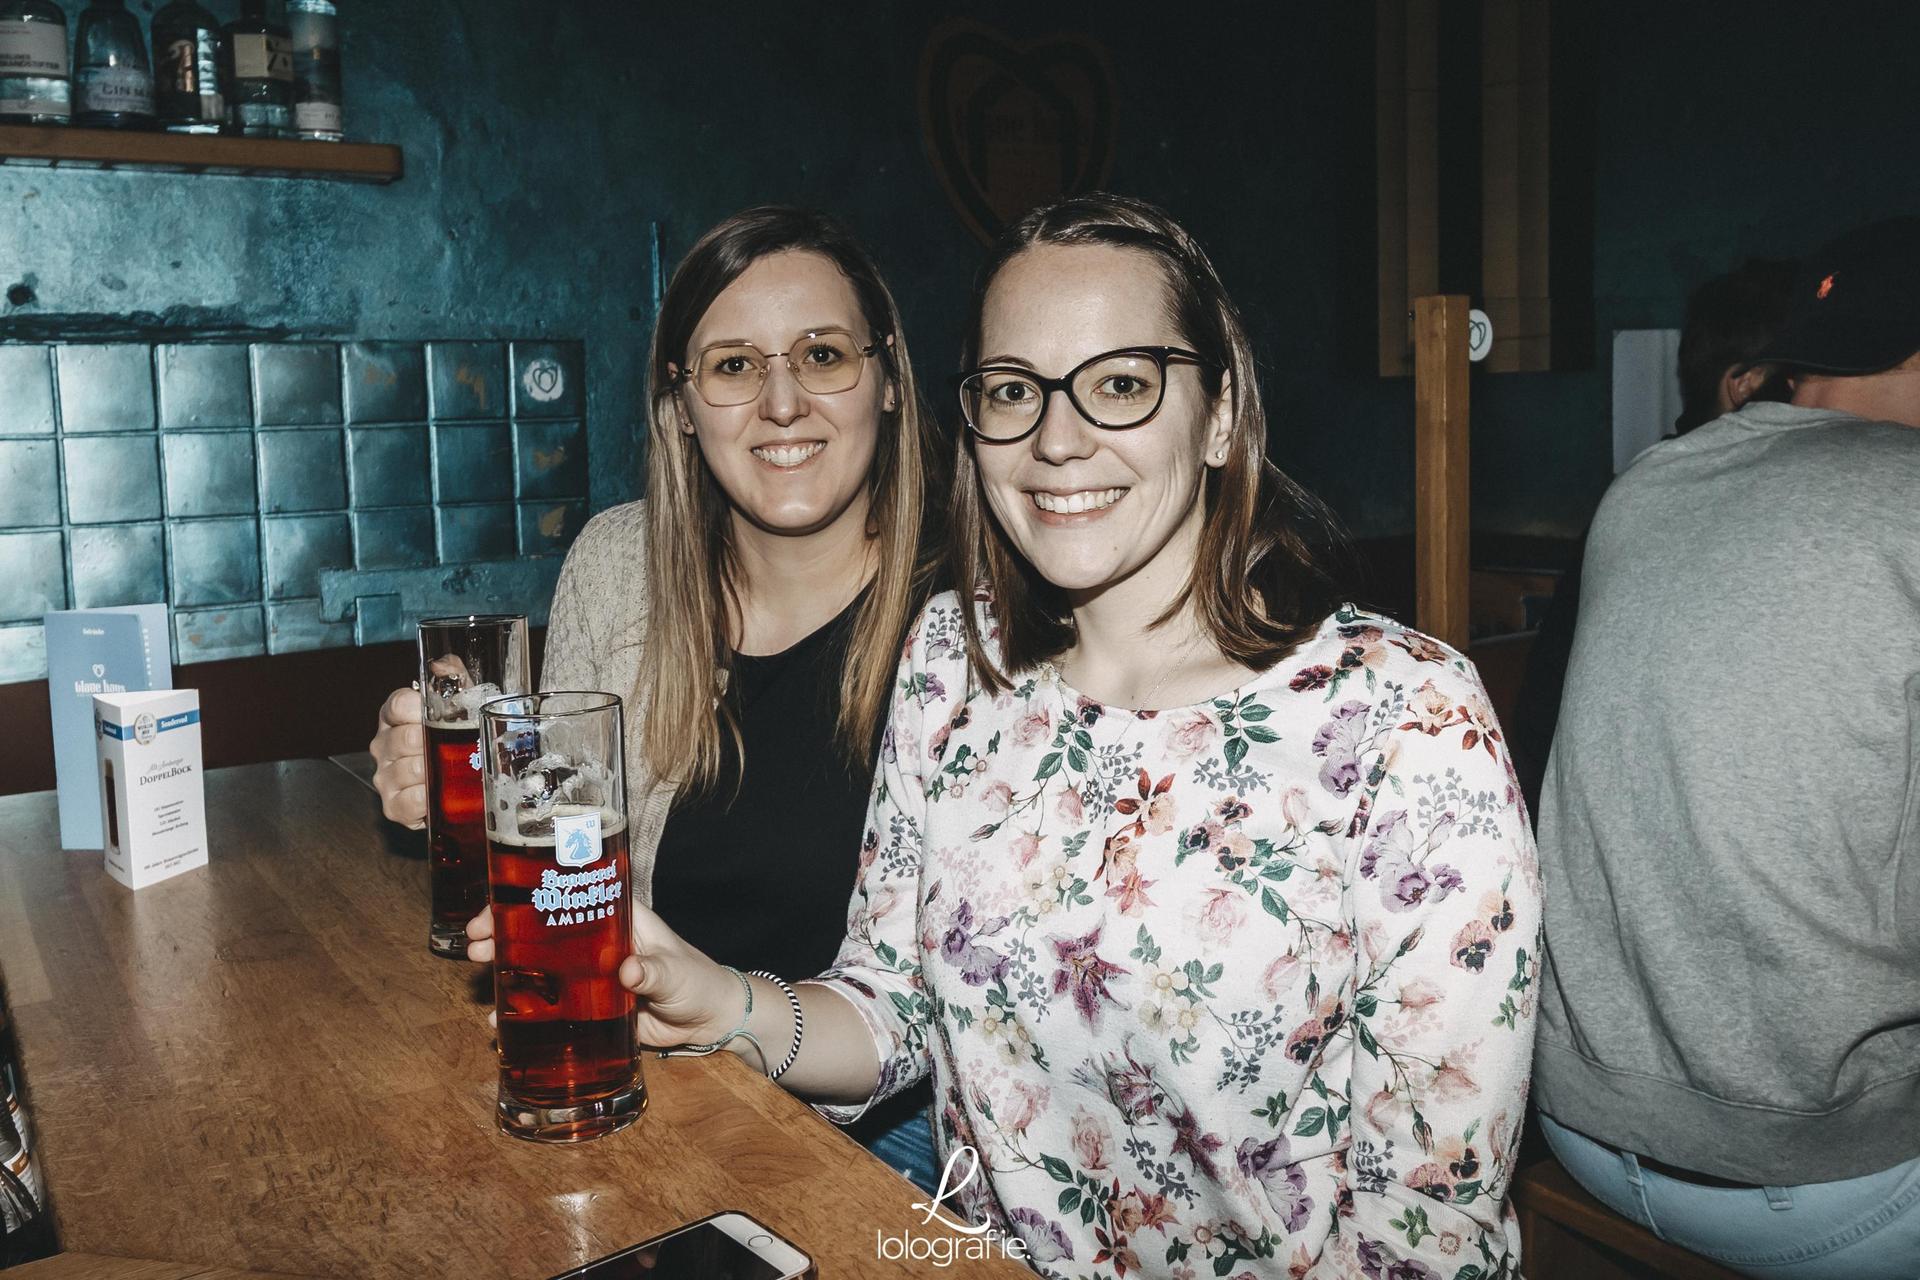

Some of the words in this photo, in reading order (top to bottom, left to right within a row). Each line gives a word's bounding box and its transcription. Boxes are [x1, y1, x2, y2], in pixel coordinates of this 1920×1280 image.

[541, 859, 617, 889] Brauerei
[532, 881, 622, 912] Winkler
[546, 905, 615, 926] AMBERG
